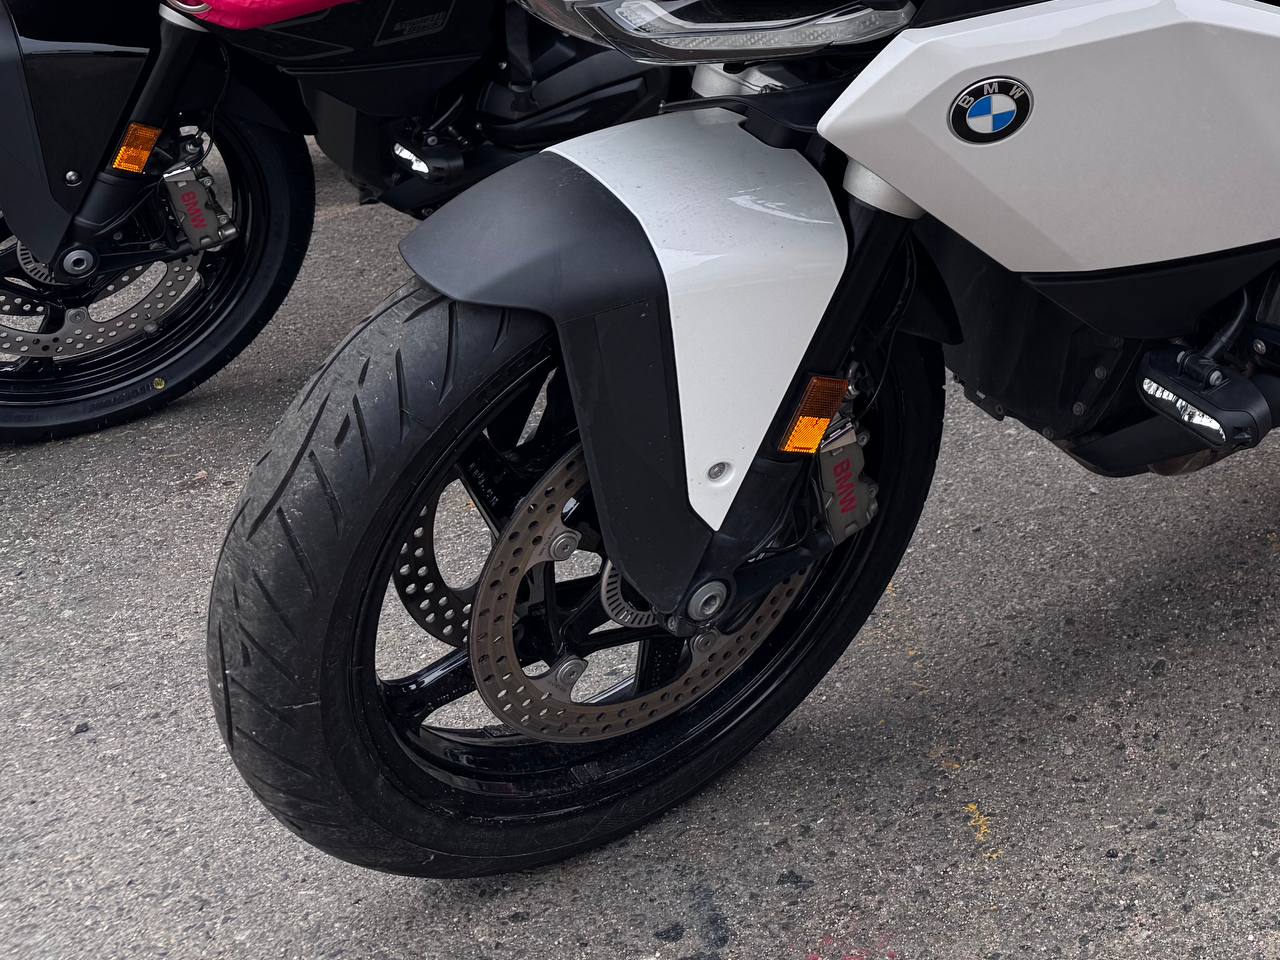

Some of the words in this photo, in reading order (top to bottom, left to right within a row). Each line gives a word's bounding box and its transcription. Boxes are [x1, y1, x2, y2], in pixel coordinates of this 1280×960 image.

[957, 82, 1025, 109] BMW
[181, 191, 209, 228] BMW
[832, 458, 858, 514] BMW
